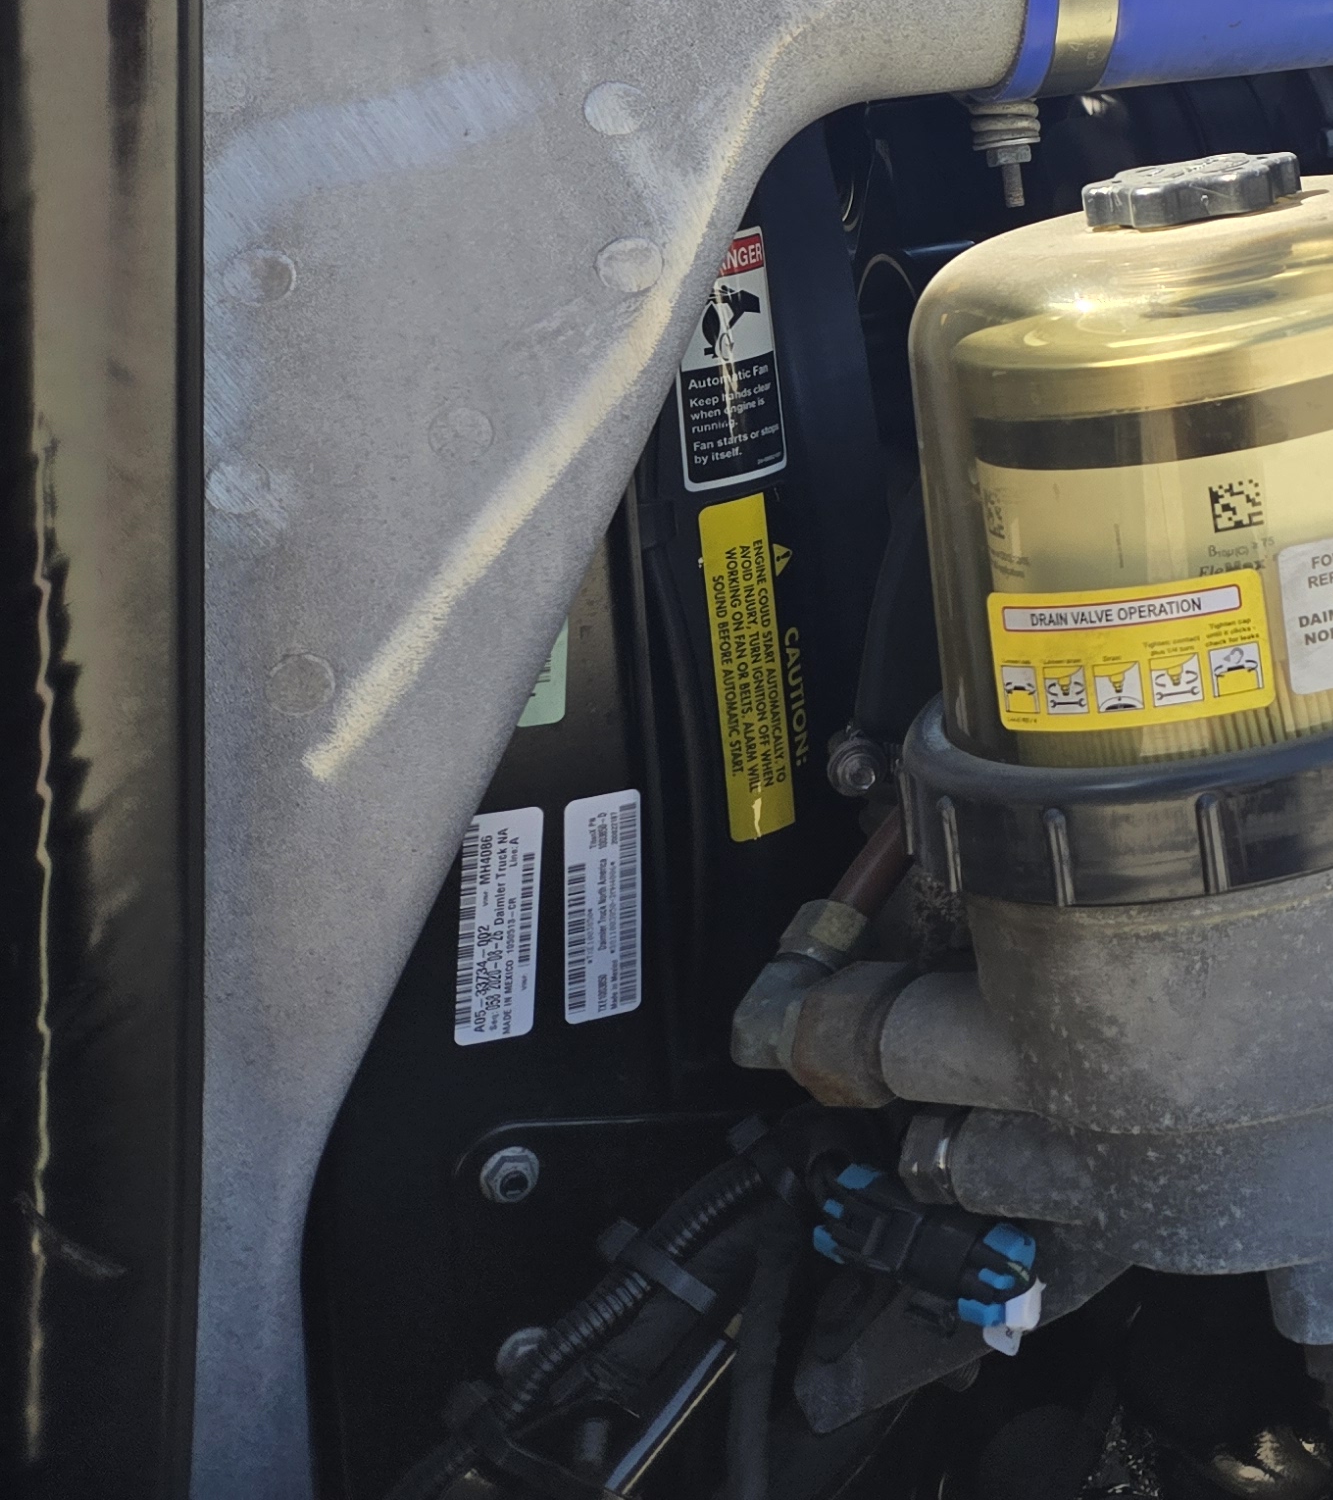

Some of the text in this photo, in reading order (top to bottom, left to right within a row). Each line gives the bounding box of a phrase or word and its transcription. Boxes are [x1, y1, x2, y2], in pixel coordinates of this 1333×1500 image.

[721, 243, 763, 270] NGER
[753, 365, 768, 377] Fan
[689, 383, 771, 408] Keep hands clear
[690, 398, 765, 420] when engine is
[693, 424, 779, 451] Fan starts or stops
[694, 447, 742, 465] by itself.
[753, 539, 767, 585] ENGINE
[758, 588, 771, 627] COULD
[1030, 596, 1202, 627] DRAIN VALVE OPERATION
[763, 631, 775, 664] START
[712, 575, 743, 777] SOUND BEFORE AUTOMATIC START.
[725, 547, 760, 793] WORKING ON FAN OR BELTS. ALARM WILL
[739, 545, 774, 787] AVOID INJURY, TURN IGNITION OFF WHEN
[785, 627, 809, 766] CAUTION:
[776, 765, 786, 783] TO
[497, 828, 508, 844] NA
[496, 848, 507, 879] Truck
[509, 846, 518, 867] Line:
[597, 859, 607, 885] America
[494, 883, 506, 926] Daimler
[474, 835, 492, 1032] A05-33734-002 MH4086
[598, 926, 607, 951] Daimler
[504, 960, 514, 994] MEXICO
[504, 997, 512, 1006] IN
[503, 1009, 512, 1034] MADE
